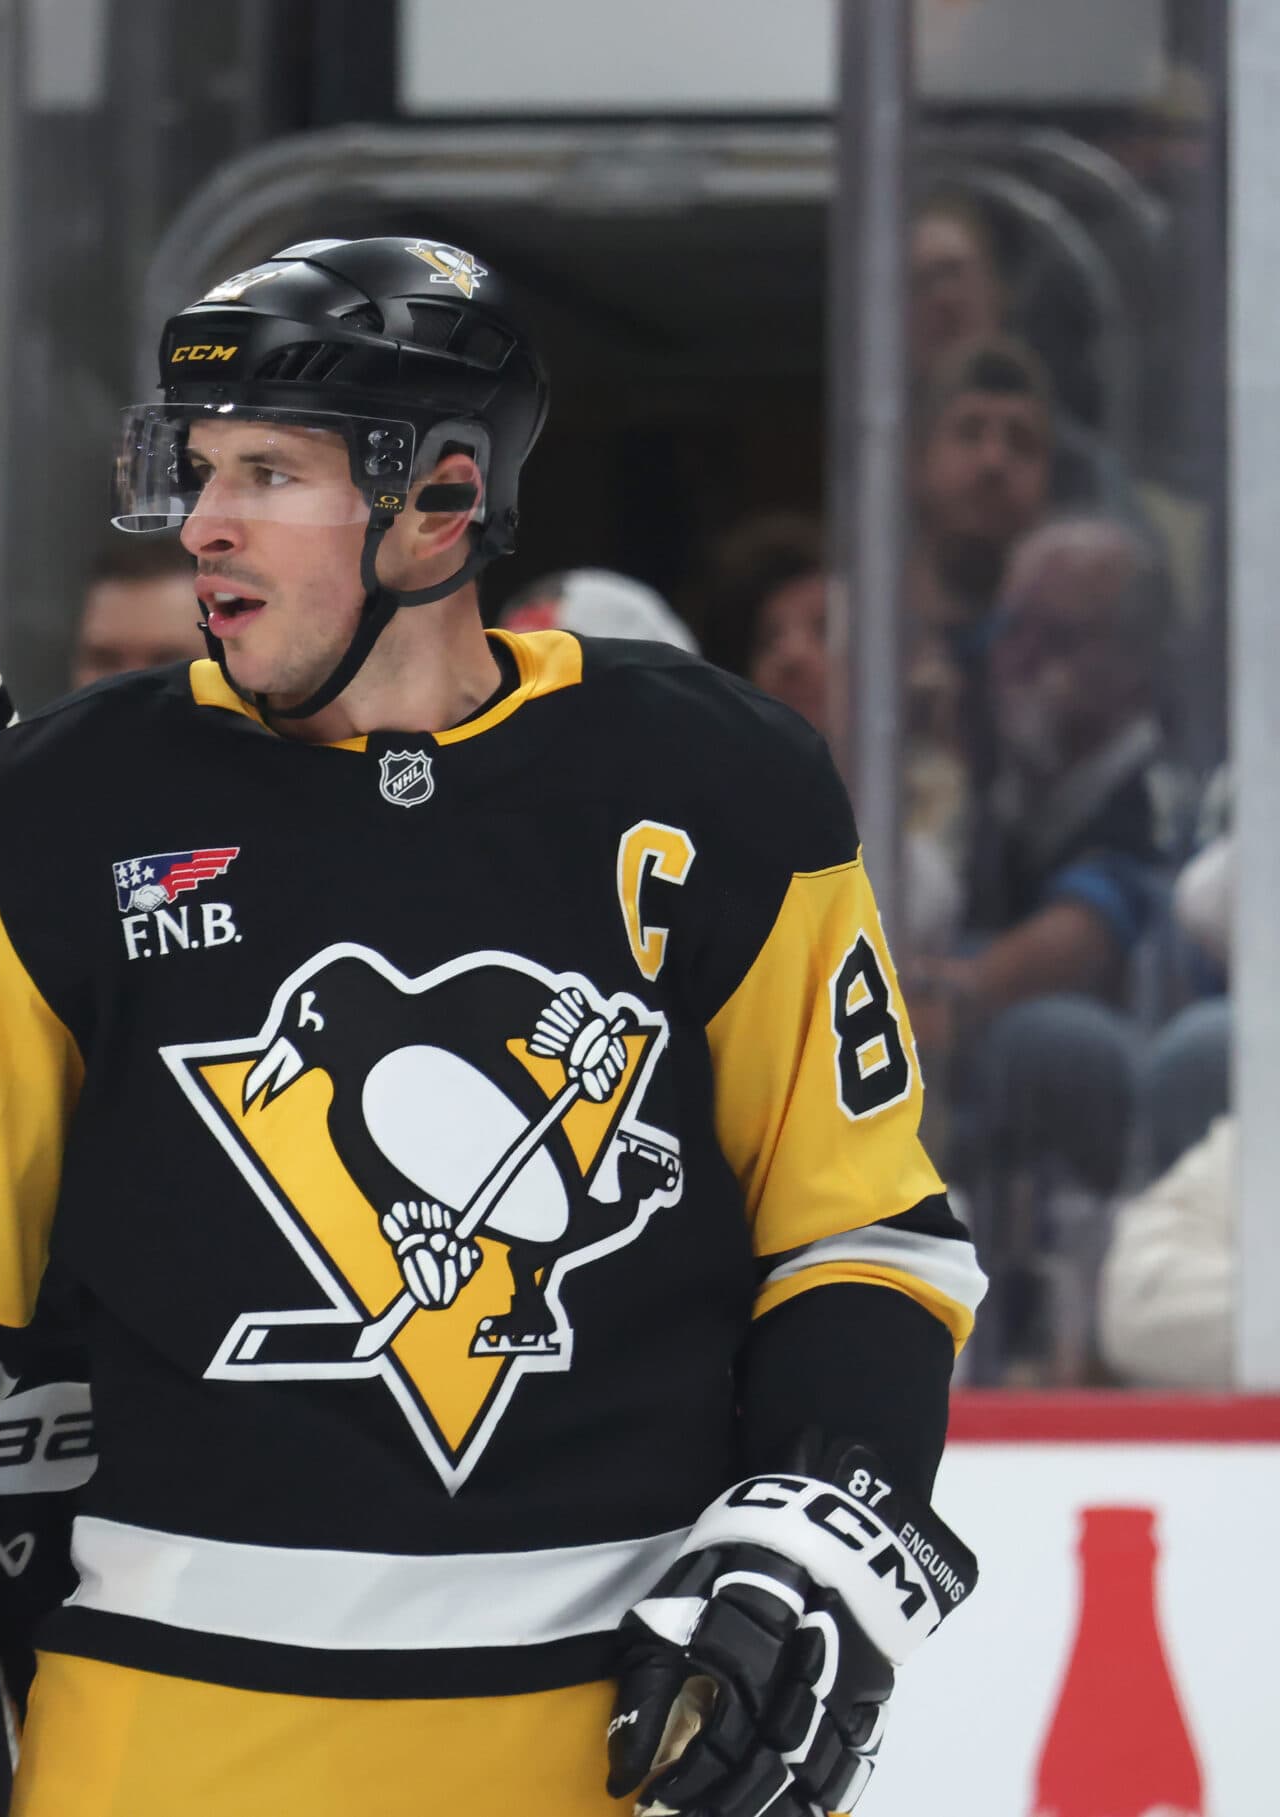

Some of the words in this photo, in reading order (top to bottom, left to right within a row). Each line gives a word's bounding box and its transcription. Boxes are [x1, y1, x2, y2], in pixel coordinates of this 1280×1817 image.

[171, 345, 239, 363] CCM
[392, 765, 422, 795] NHL
[616, 819, 696, 982] C
[121, 902, 242, 960] F.N.B.
[847, 1468, 892, 1509] 87
[725, 1476, 928, 1622] CCM
[897, 1521, 966, 1603] ENGUINS
